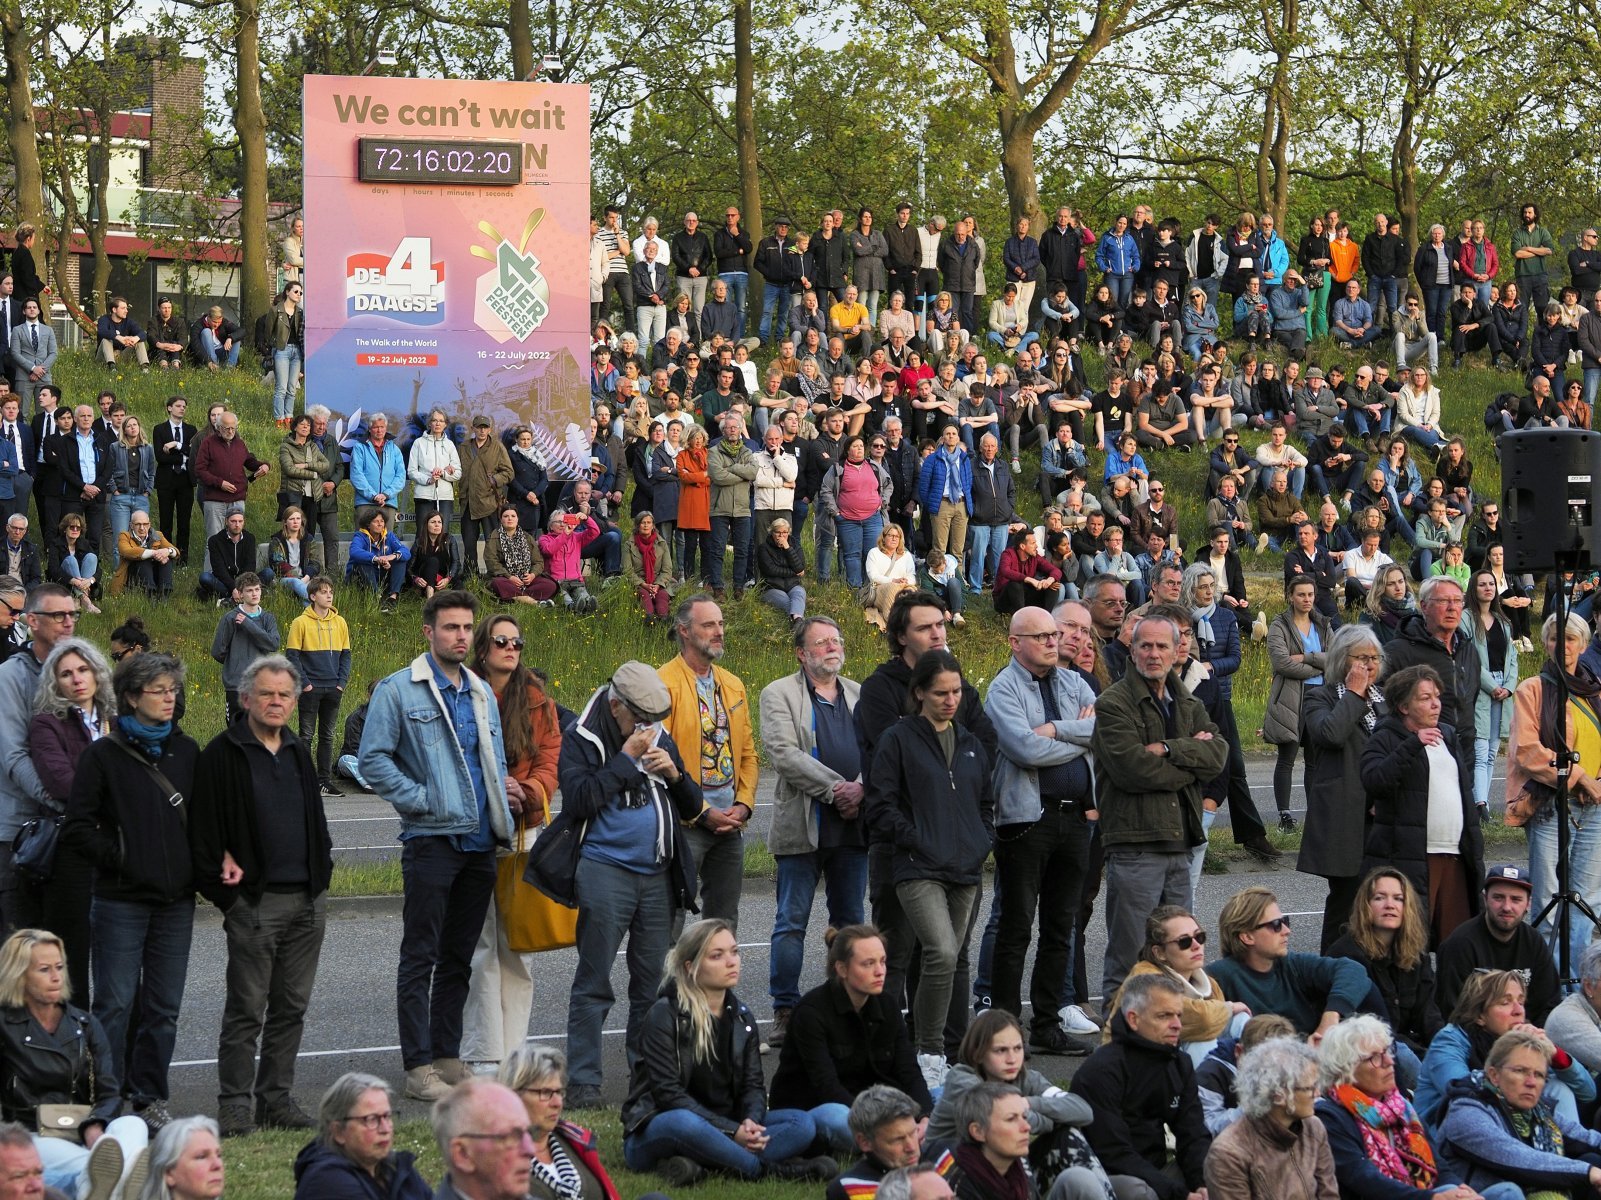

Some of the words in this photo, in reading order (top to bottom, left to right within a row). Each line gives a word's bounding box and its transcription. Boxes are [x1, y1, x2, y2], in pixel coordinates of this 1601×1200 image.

[333, 94, 389, 125] We
[489, 100, 565, 130] wait
[375, 148, 511, 173] 72:16:02:20
[525, 143, 548, 169] N
[371, 187, 389, 195] days
[447, 189, 475, 197] minutes
[486, 190, 514, 198] seconds
[355, 268, 381, 285] DE
[386, 237, 438, 295] 4
[355, 295, 438, 313] DAAGSE
[486, 294, 527, 338] FEESTEN
[493, 287, 534, 330] DAAGSE
[356, 338, 369, 346] The
[371, 338, 390, 346] Walk
[415, 339, 437, 347] World
[381, 356, 391, 364] 22
[392, 356, 407, 365] July
[408, 356, 427, 364] 2022
[477, 350, 487, 359] 16
[495, 351, 506, 359] 22
[507, 351, 526, 361] July
[527, 351, 550, 360] 2022
